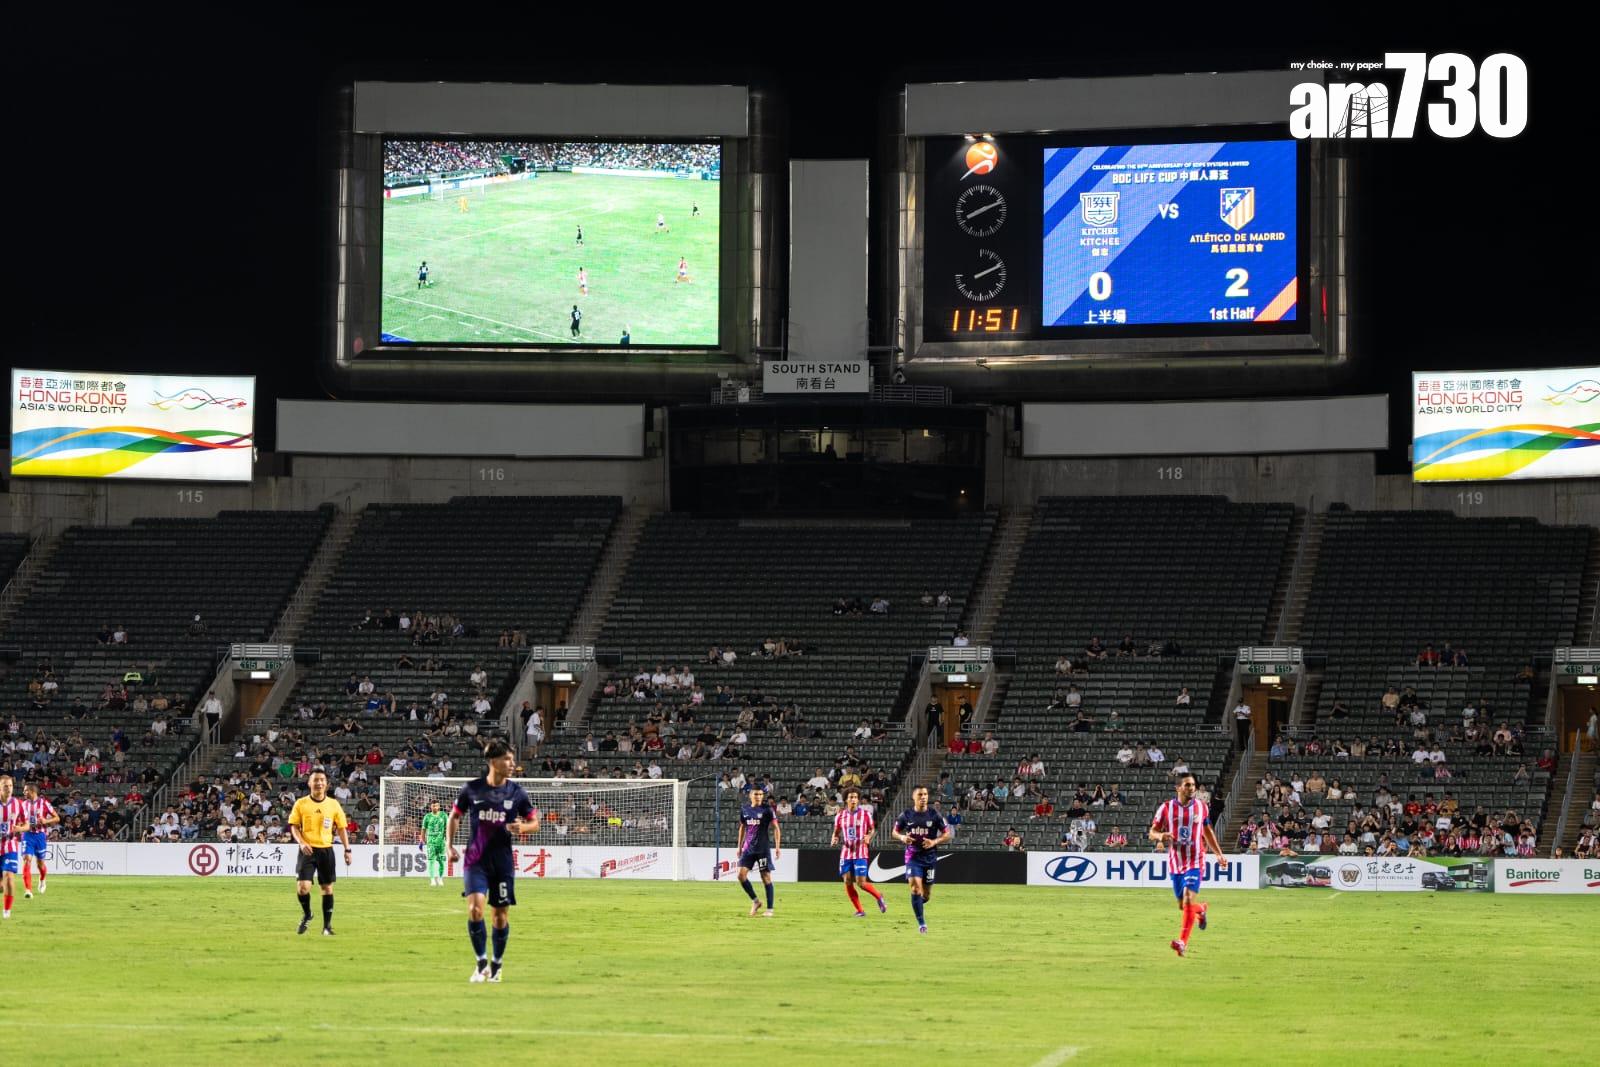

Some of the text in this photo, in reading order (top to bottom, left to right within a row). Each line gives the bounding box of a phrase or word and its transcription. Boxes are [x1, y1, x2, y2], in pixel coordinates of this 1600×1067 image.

[1112, 173, 1132, 184] BOC
[1134, 172, 1156, 183] LIFE
[1158, 171, 1178, 183] CUP
[1158, 203, 1180, 219] VS
[1081, 228, 1118, 236] KITCHEE
[1190, 232, 1286, 243] ATLÉTICO DE MADRID
[1080, 237, 1120, 246] KITCHEE
[1088, 271, 1112, 301] 0
[1225, 267, 1249, 298] 2
[952, 309, 1018, 331] 11:51
[1084, 309, 1127, 324] 上半場
[1209, 307, 1255, 320] 1st Half
[772, 363, 861, 374] SOUTH STAND
[20, 376, 127, 392] 香港亞洲國際都會
[796, 377, 836, 390] 南看台
[1418, 378, 1522, 392] 香港亞洲國際都會
[19, 389, 127, 406] HONG KONG
[1418, 390, 1523, 406] HONG KONG
[19, 402, 127, 414] ASIA'S WORLD CITY
[1418, 404, 1522, 415] ASIA'S WORLD CITY
[480, 468, 505, 481] 116
[1157, 467, 1183, 480] 118
[177, 490, 203, 503] 115
[1457, 492, 1483, 505] 119
[479, 808, 507, 823] edps
[911, 826, 929, 836] edps
[373, 846, 427, 877] edps
[1366, 860, 1416, 875] 冠忠巴士
[227, 865, 284, 874] BOC LIFE
[1506, 868, 1560, 880] Banitore
[1584, 868, 1600, 880] Ba
[498, 881, 508, 898] 6
